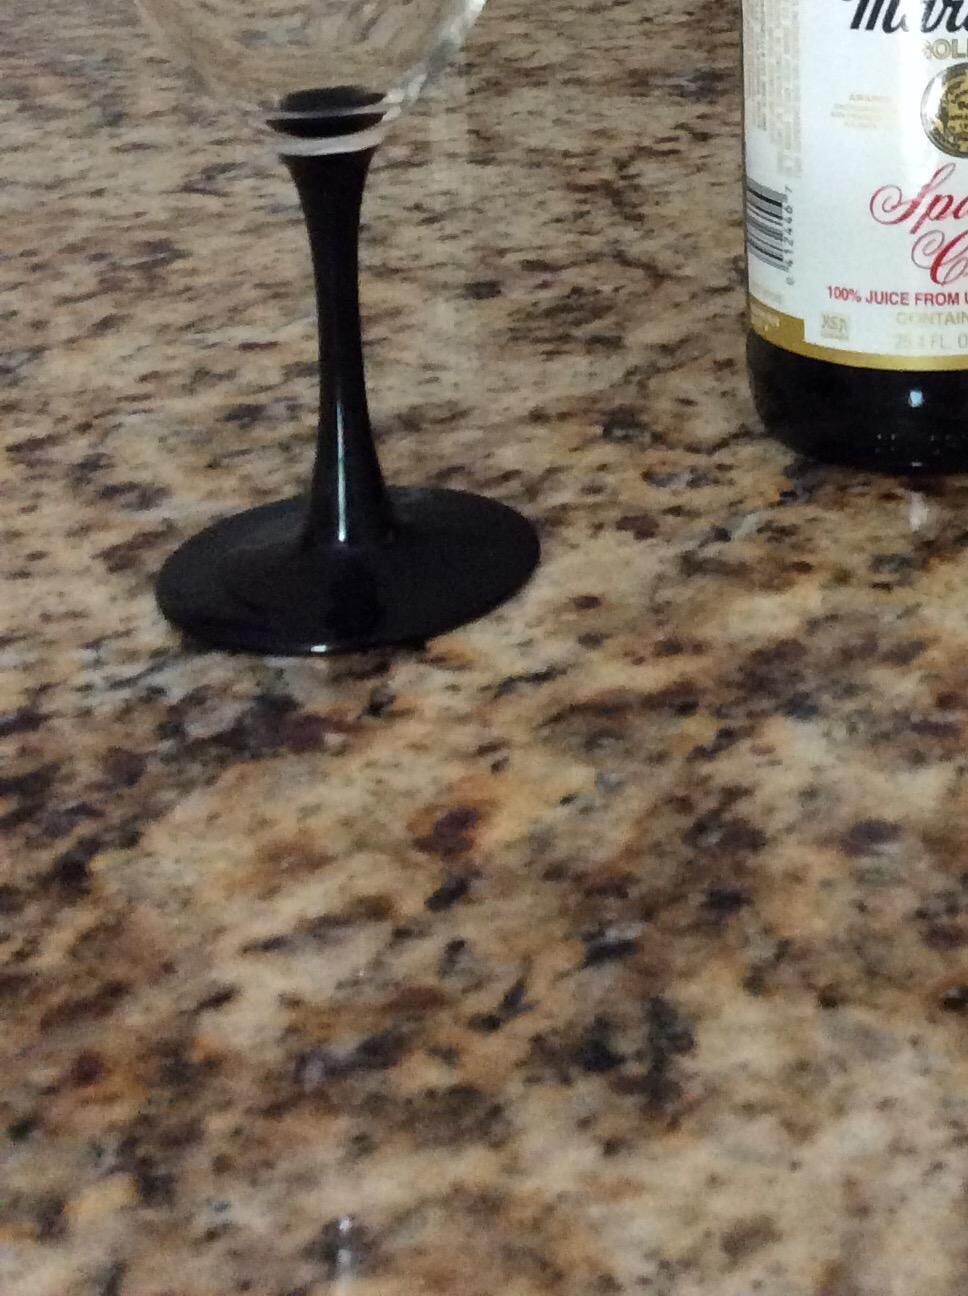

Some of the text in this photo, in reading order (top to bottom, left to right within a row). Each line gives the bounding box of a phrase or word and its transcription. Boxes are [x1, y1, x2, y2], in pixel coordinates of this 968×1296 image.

[827, 286, 862, 304] 100%
[866, 290, 910, 306] JUICE
[914, 291, 960, 306] FROM
